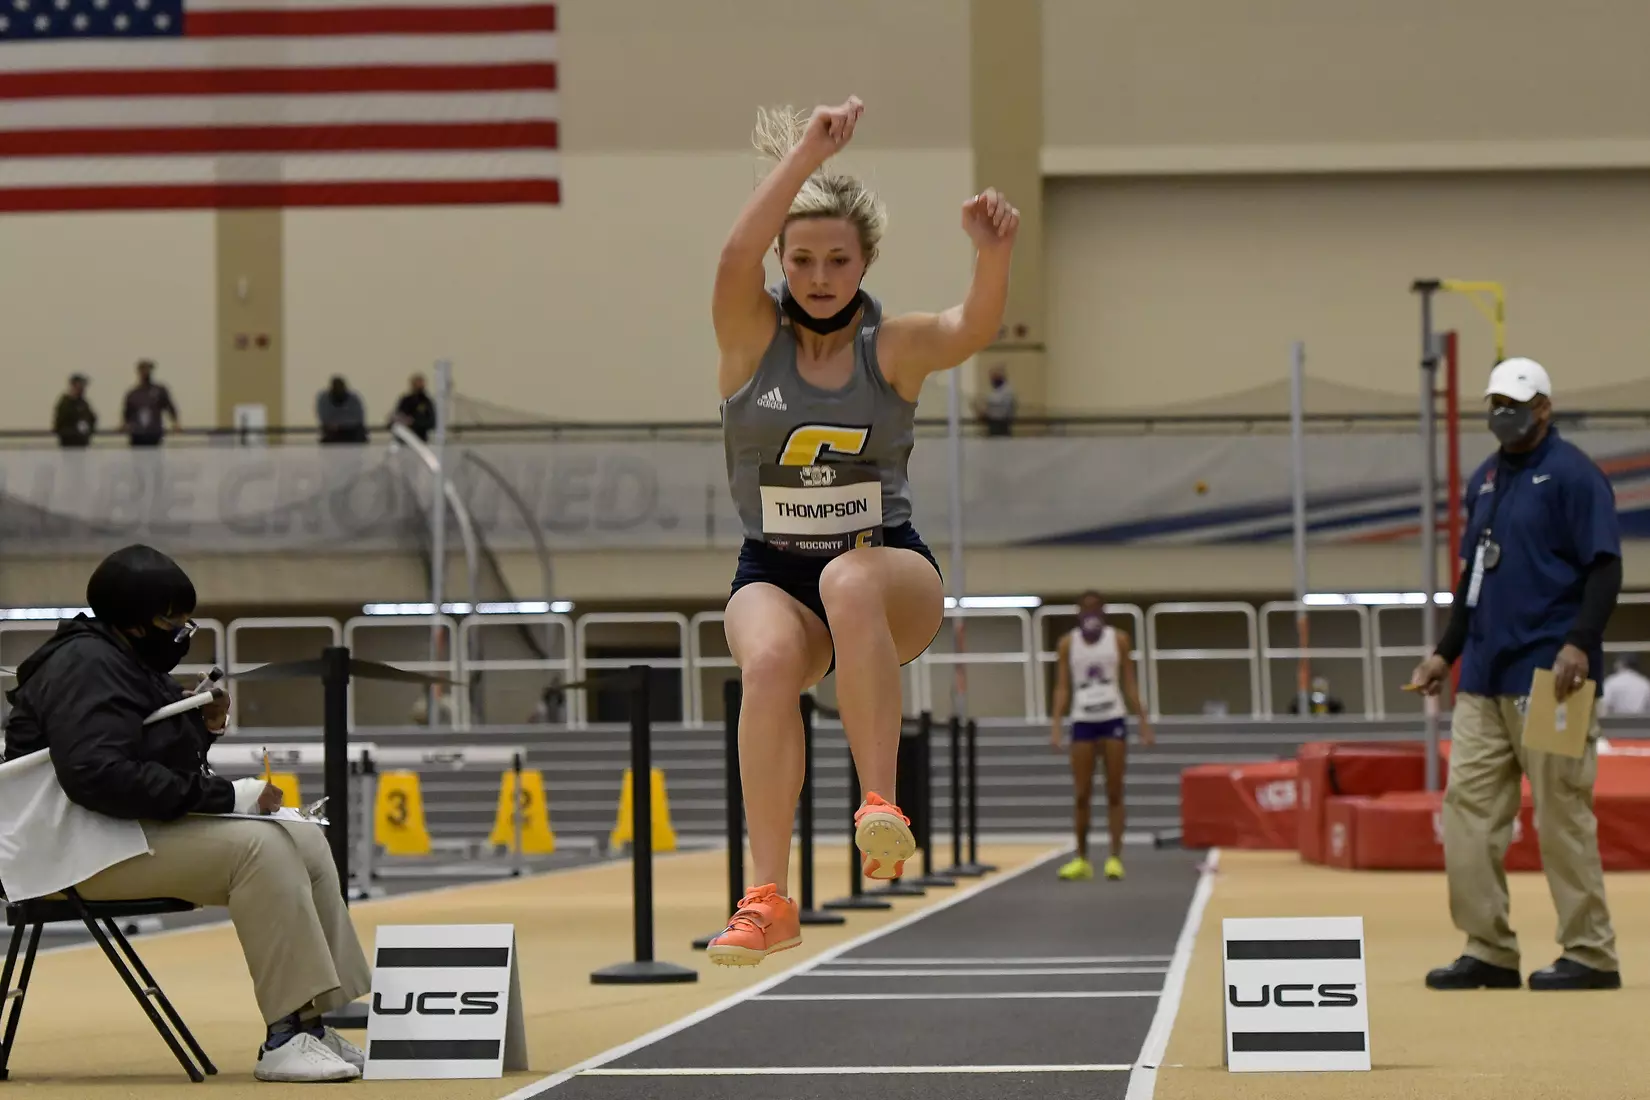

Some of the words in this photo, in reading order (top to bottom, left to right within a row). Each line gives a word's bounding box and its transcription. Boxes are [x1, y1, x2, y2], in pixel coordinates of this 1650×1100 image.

[757, 398, 787, 411] adidas
[775, 498, 868, 518] THOMPSON
[386, 788, 408, 827] 3
[372, 991, 499, 1016] UCS
[1229, 983, 1358, 1008] UCS
